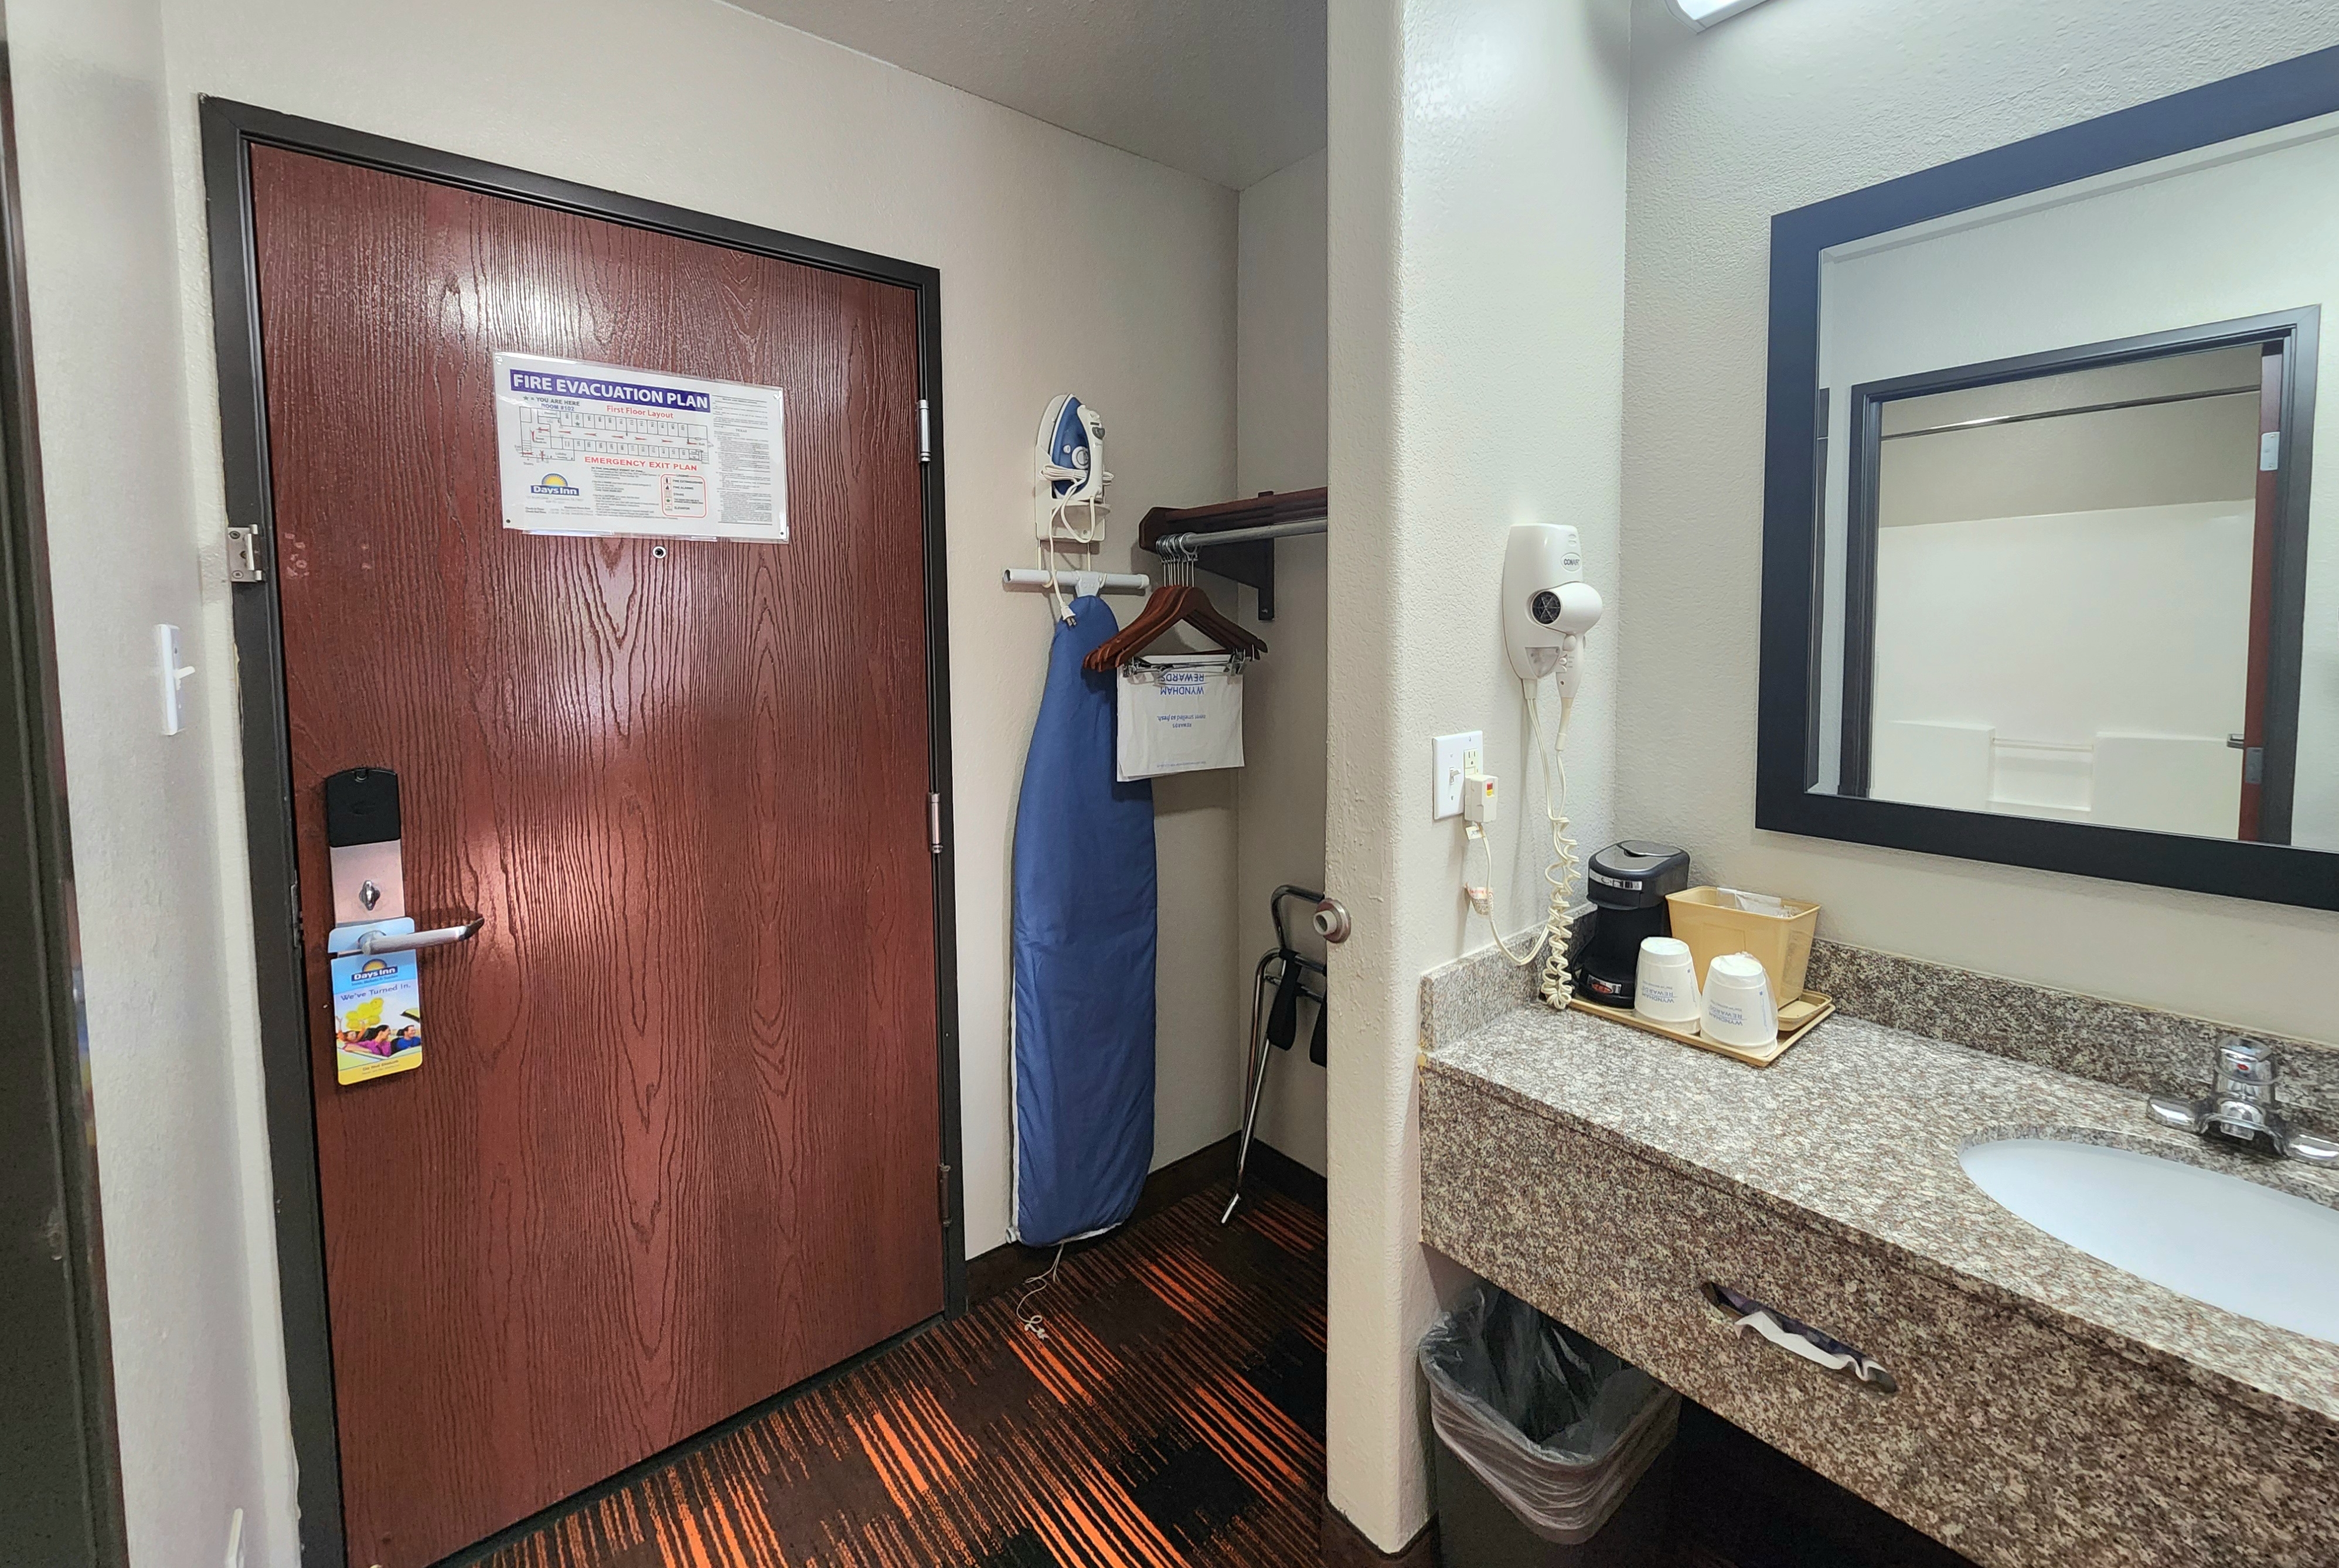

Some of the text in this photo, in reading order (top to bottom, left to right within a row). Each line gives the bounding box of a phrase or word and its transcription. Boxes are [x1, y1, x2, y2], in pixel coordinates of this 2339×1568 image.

[513, 373, 708, 408] FIRE EVACUATION PLAN
[626, 407, 646, 415] Floor
[648, 410, 673, 418] Layout
[584, 456, 646, 467] EMERGENCY
[649, 461, 670, 469] EXIT
[533, 486, 559, 494] Days
[1160, 673, 1204, 682] REWARDS
[1160, 686, 1204, 696] WYNDHAM
[1156, 714, 1170, 722] fresh.
[354, 967, 396, 981] Days Inn
[341, 993, 367, 1001] We've
[369, 984, 398, 996] Turned
[1642, 992, 1674, 1003] WYNDHAM
[1709, 1011, 1743, 1026] WYNDHAM
